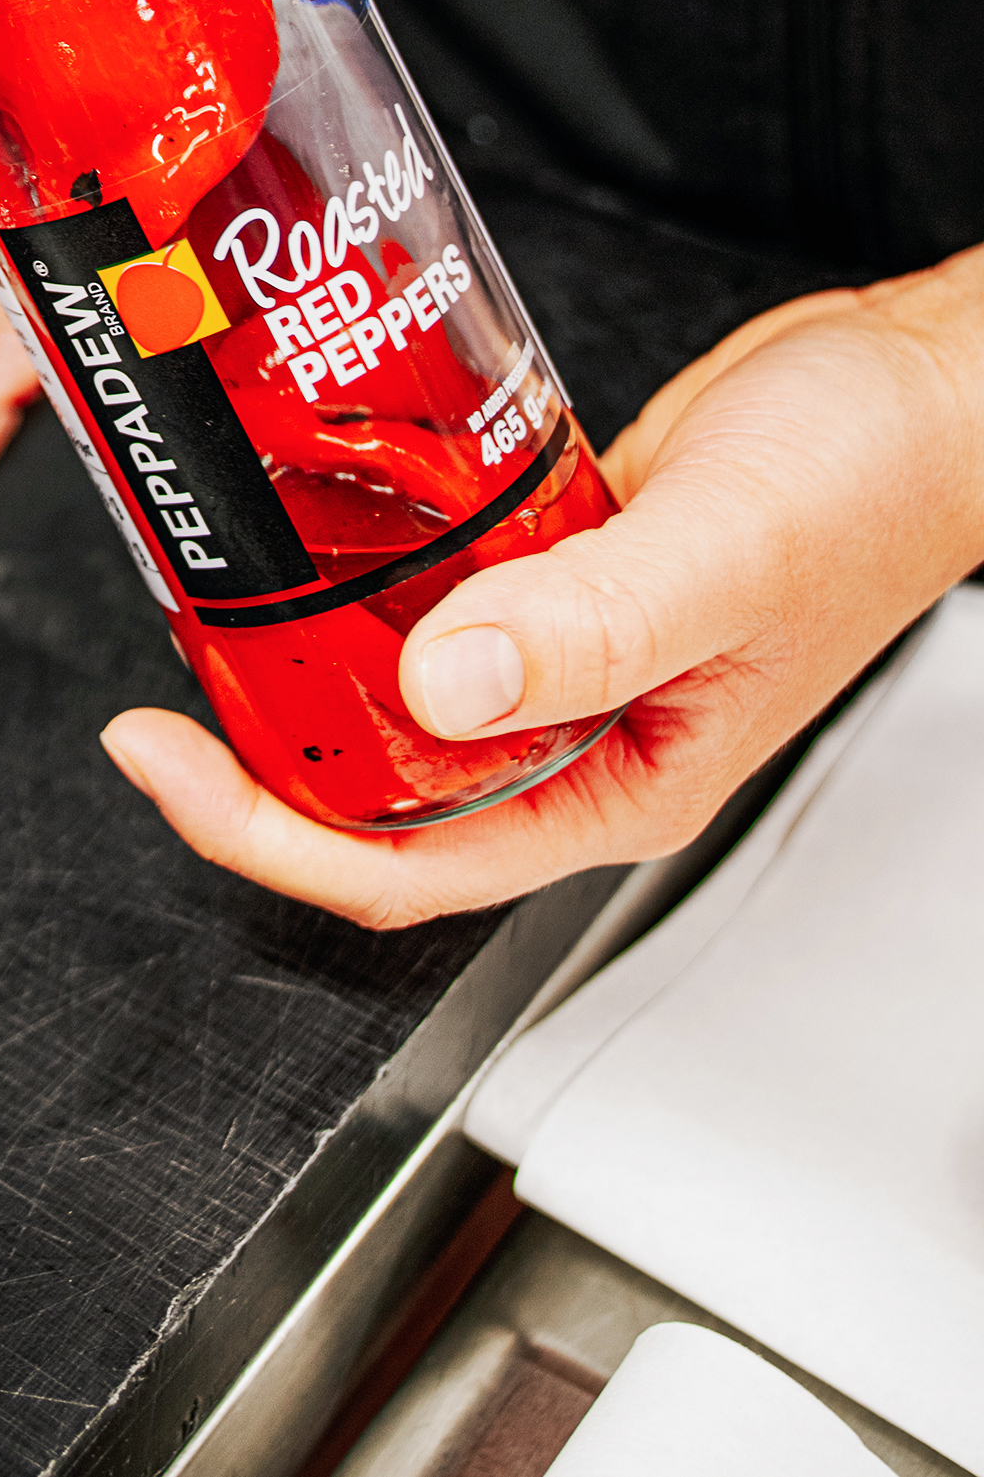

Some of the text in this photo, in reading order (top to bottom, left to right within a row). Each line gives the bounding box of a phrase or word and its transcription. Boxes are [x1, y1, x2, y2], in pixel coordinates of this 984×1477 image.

[213, 103, 434, 309] Roasted
[87, 282, 125, 336] BRAND
[263, 270, 372, 358] RED
[287, 243, 472, 404] PEPPERS
[41, 281, 228, 569] PEPPADEW
[466, 410, 486, 434] NO
[480, 394, 544, 467] 465 g
